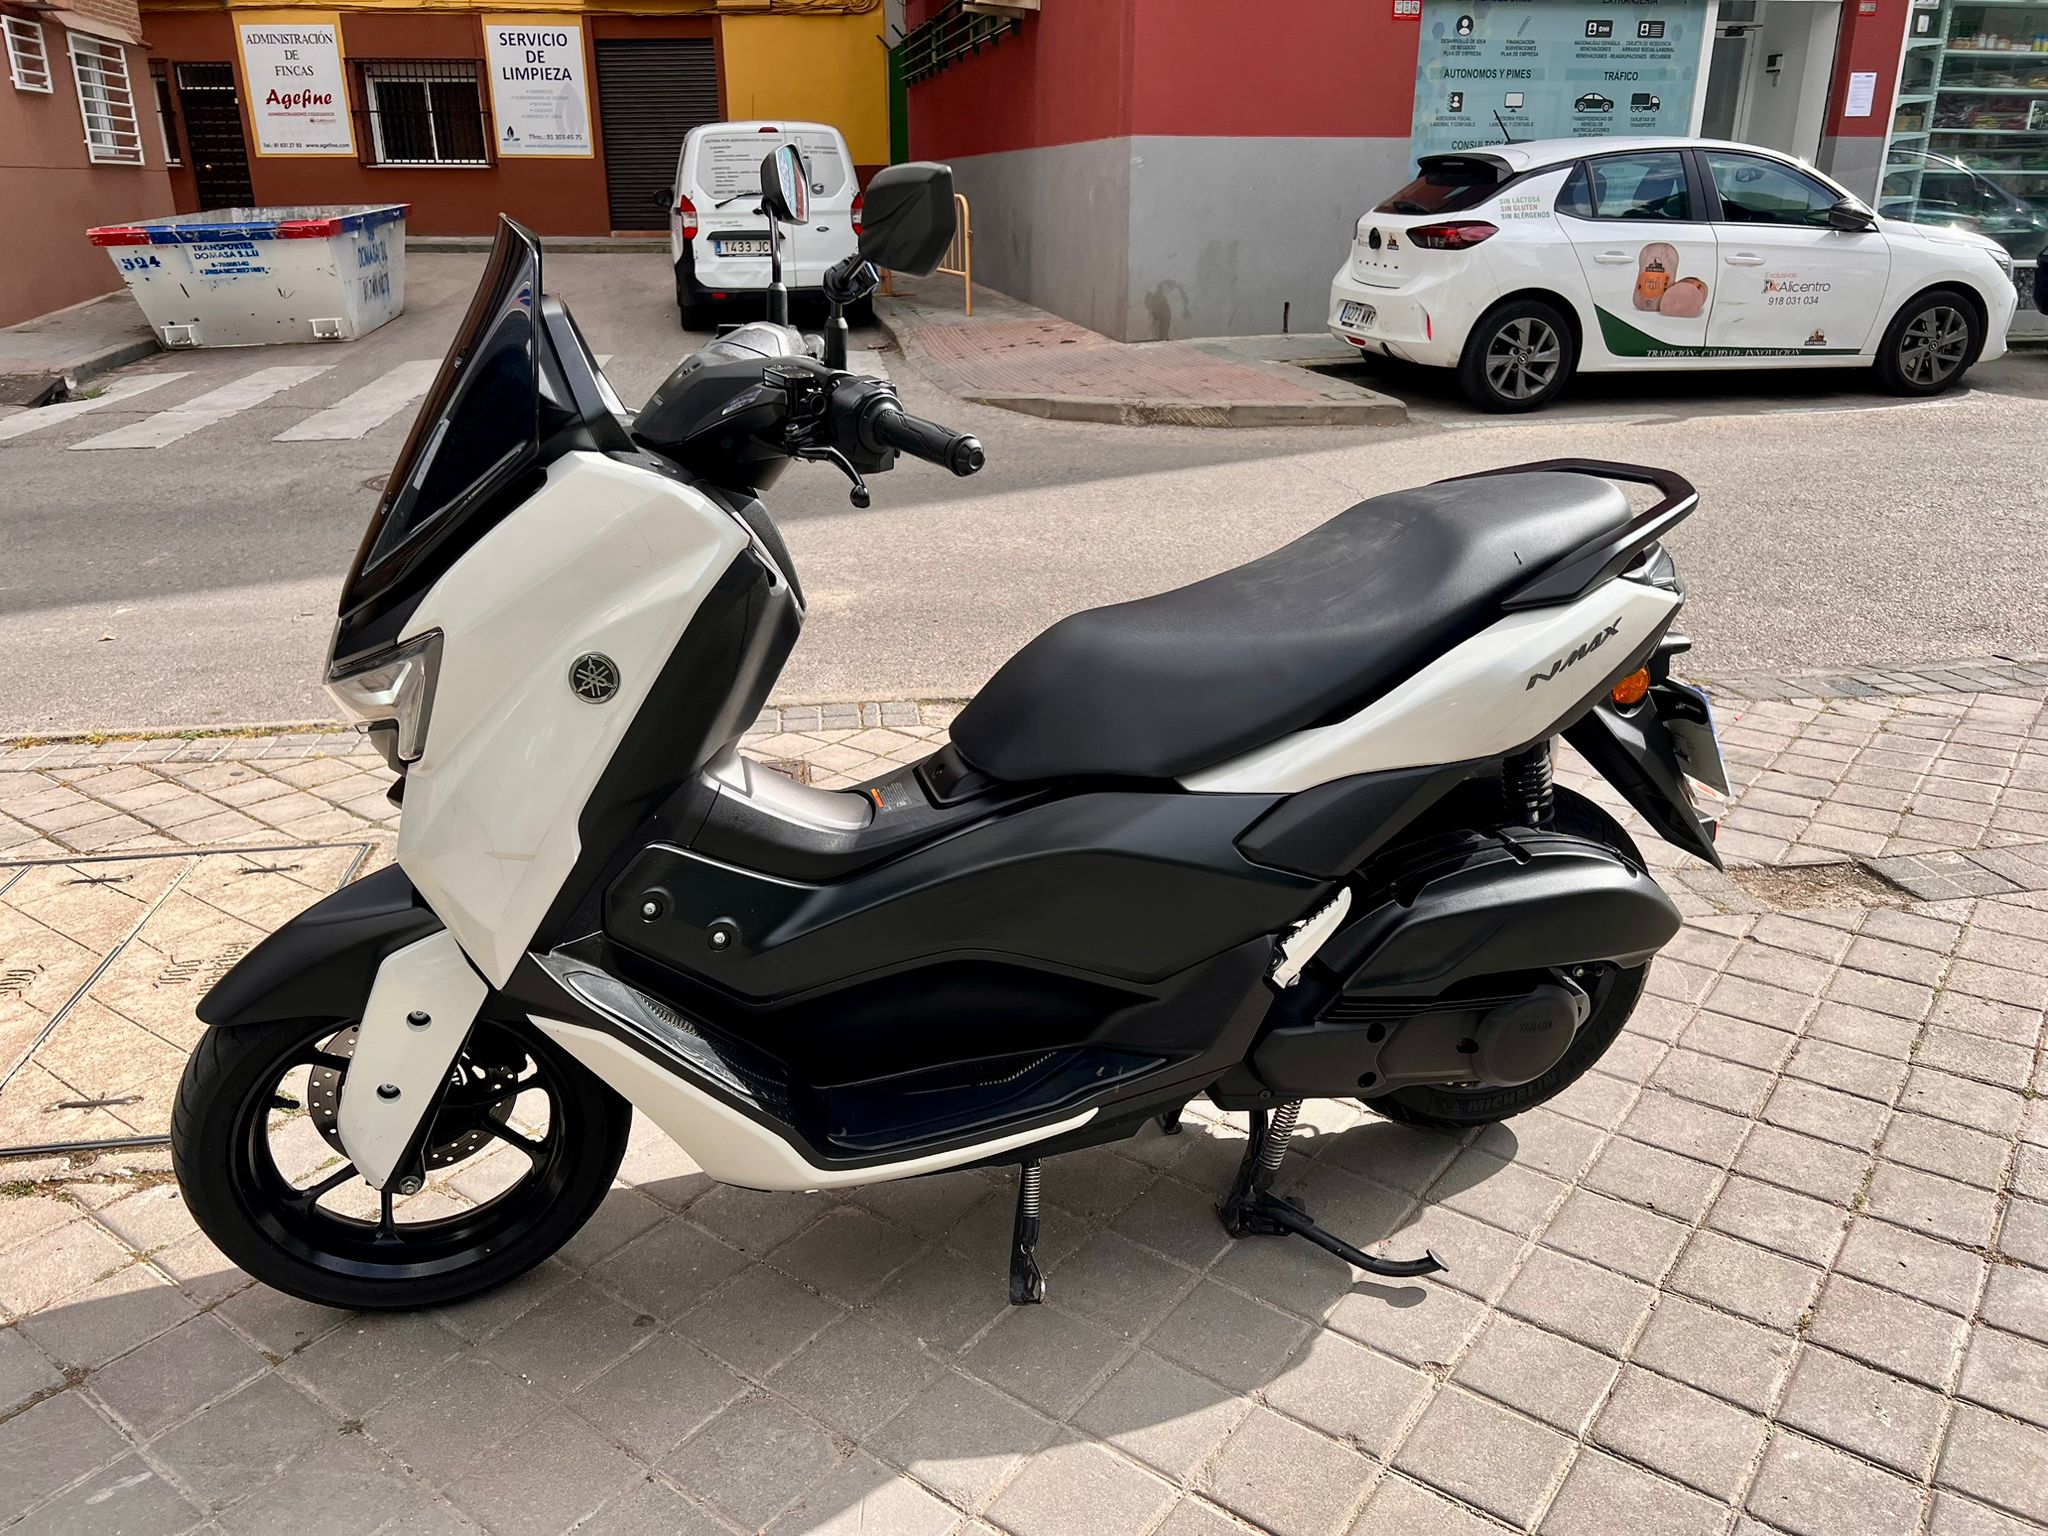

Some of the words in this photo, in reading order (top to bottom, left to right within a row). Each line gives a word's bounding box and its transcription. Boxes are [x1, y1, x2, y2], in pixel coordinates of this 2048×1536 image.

[246, 30, 333, 45] ADMINISTRACIÓN
[499, 32, 568, 47] SERVICIO
[284, 50, 299, 60] DE
[526, 50, 546, 63] DE
[275, 66, 314, 76] FINCAS
[502, 67, 572, 81] LIMPIEZA
[1443, 69, 1497, 79] AUTONOMOS
[1499, 69, 1505, 79] Y
[1506, 69, 1532, 79] PIMES
[1604, 69, 1639, 81] TRÁFICO
[266, 89, 333, 109] Agefine
[1511, 196, 1541, 204] LACTOSA
[191, 241, 255, 251] TRANSPORTES
[724, 241, 752, 252] 1433
[755, 241, 769, 252] JC
[194, 251, 236, 260] DOMASA
[1778, 280, 1831, 293] Alicentro
[1768, 296, 1784, 305] 918
[1785, 296, 1801, 305] 031
[1803, 296, 1819, 305] 034
[1701, 349, 1740, 357] CALIDAD
[1525, 616, 1622, 691] NMAX
[1519, 1018, 1553, 1033] YAMAHA
[1468, 1071, 1560, 1113] MICHELIN
